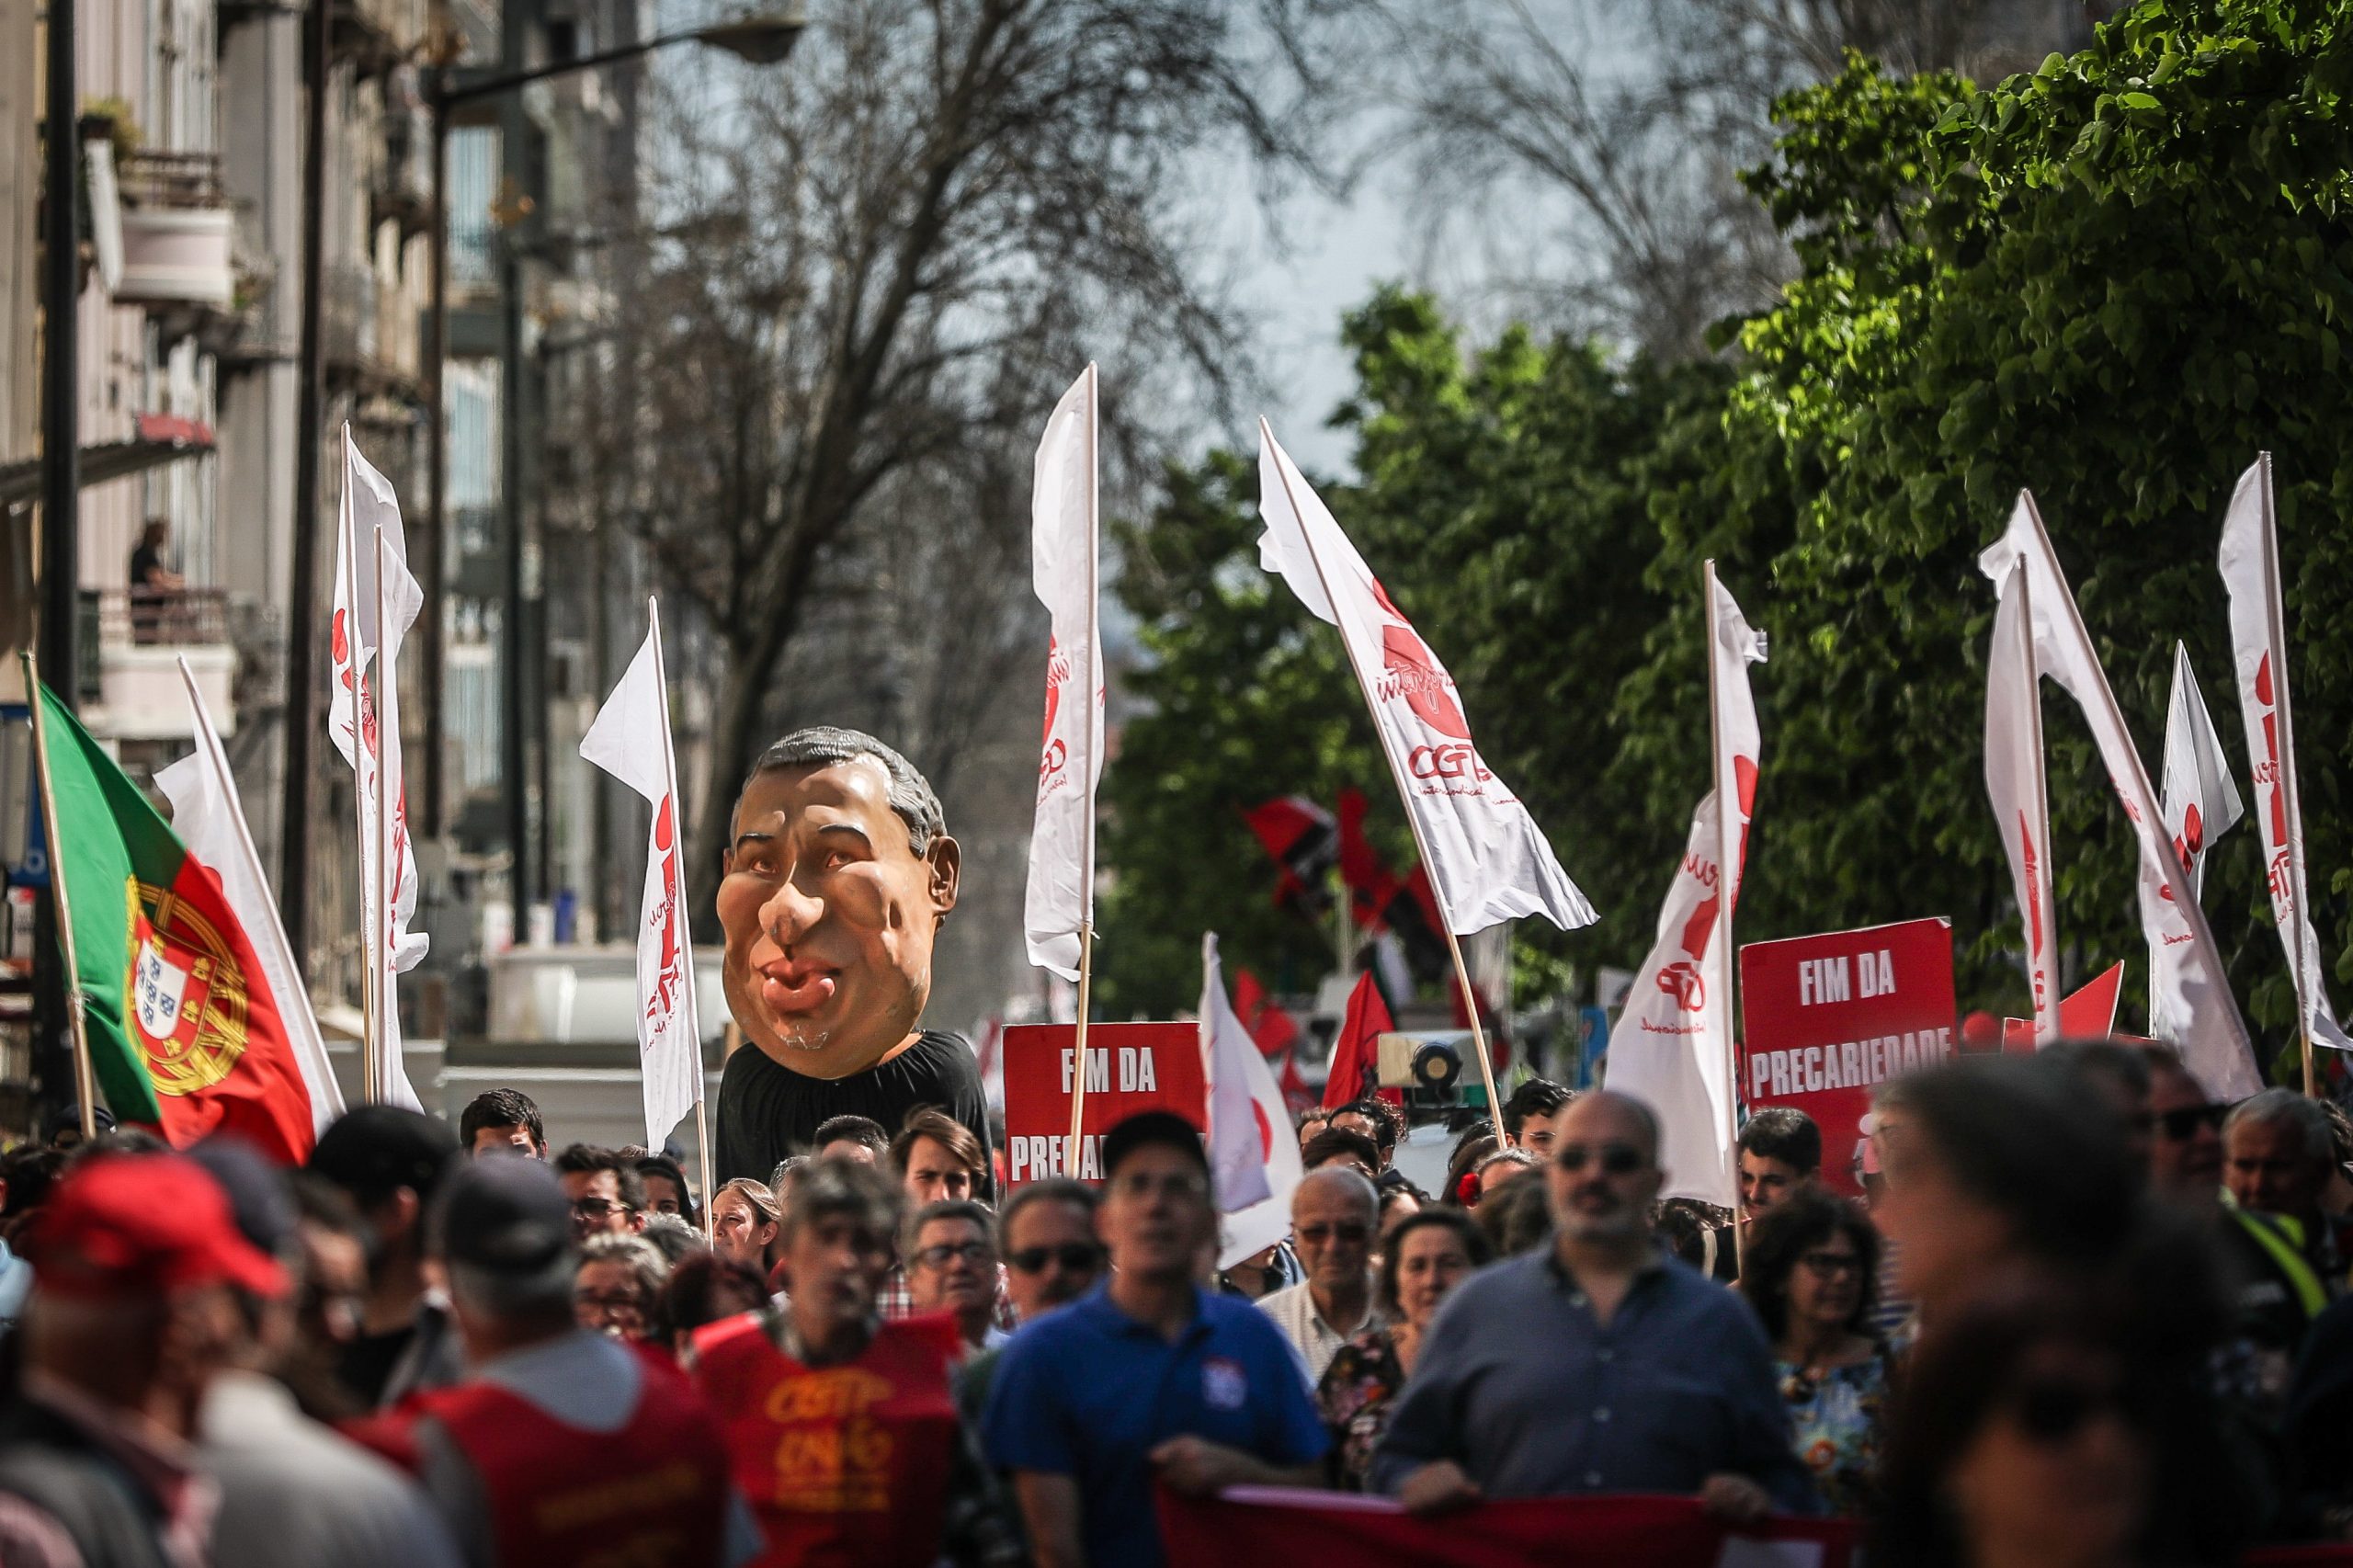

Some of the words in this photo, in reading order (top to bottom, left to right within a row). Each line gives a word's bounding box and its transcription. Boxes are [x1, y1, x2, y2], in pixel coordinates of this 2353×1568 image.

[1799, 956, 1851, 1006] FIM
[1858, 949, 1896, 999] DA
[1061, 1048, 1110, 1094] FM
[1119, 1046, 1157, 1093] DA
